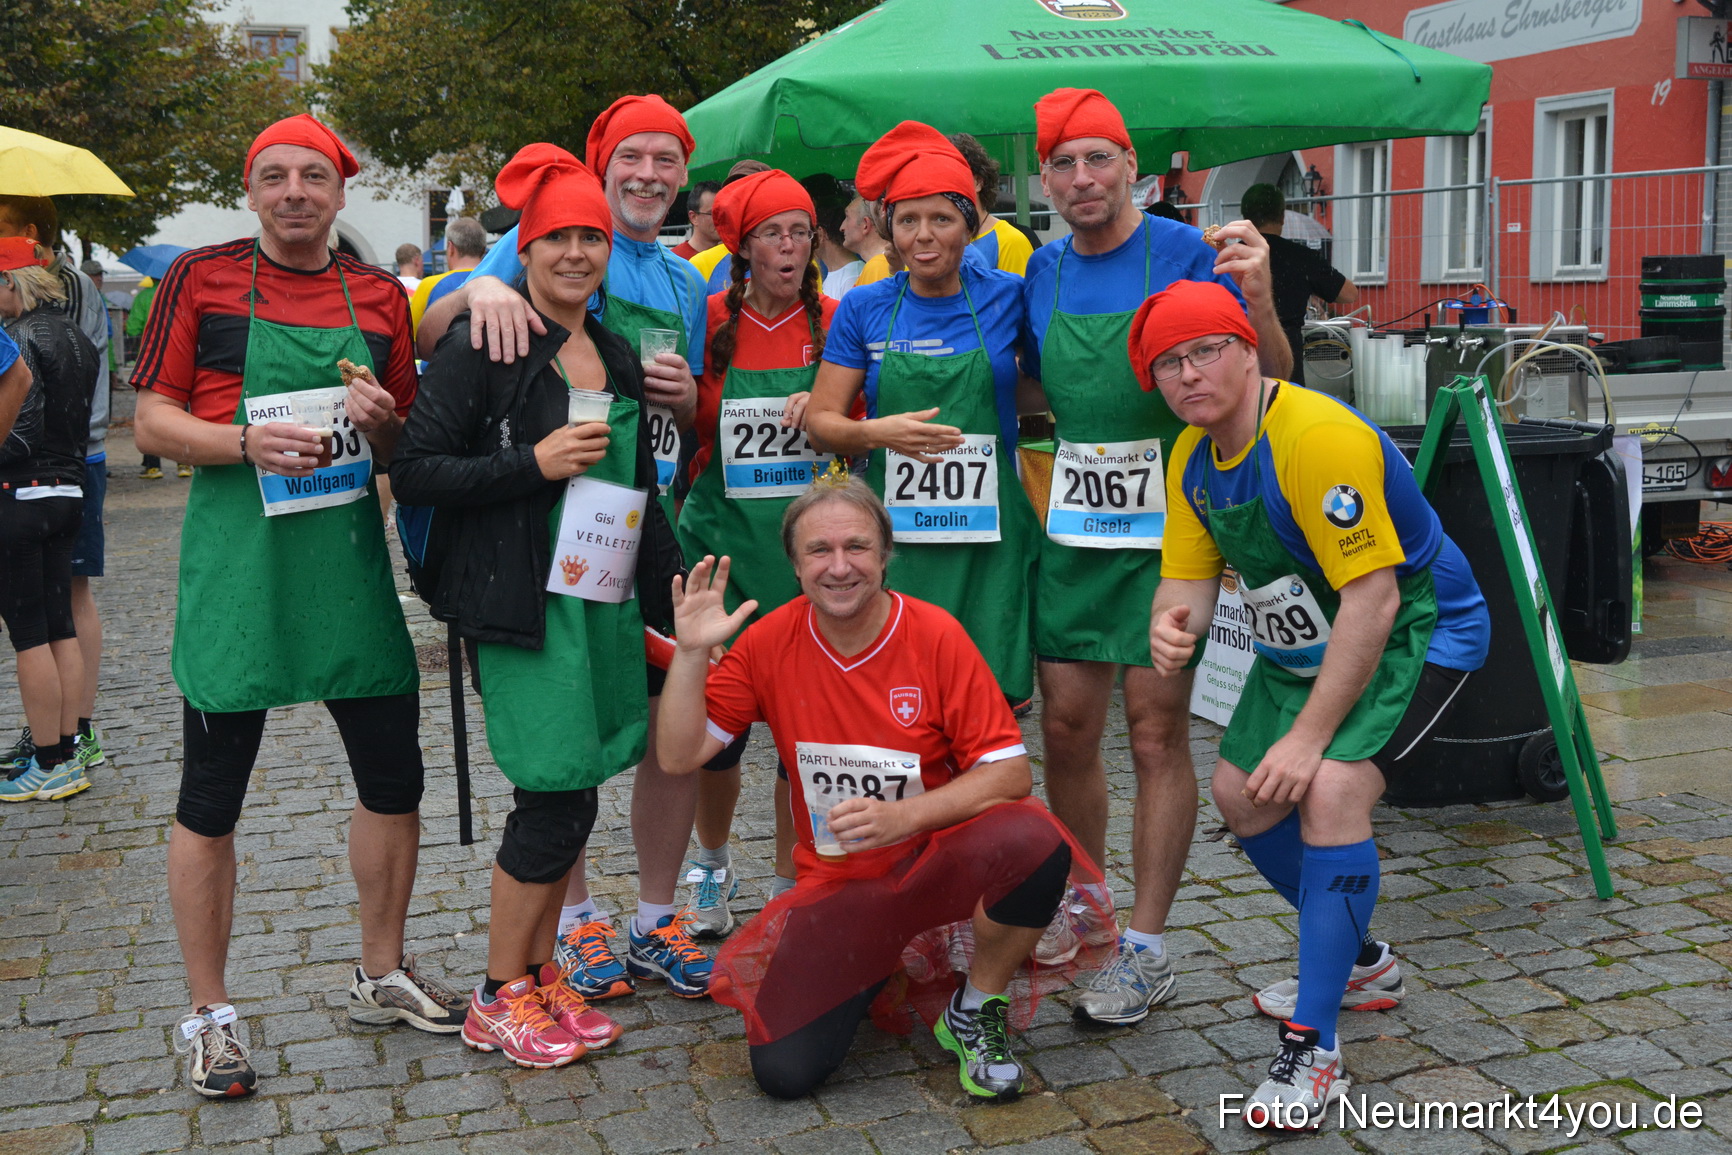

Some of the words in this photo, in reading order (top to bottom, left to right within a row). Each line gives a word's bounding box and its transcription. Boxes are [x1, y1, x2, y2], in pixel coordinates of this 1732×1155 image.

[1008, 27, 1215, 41] Neumarkter
[1413, 12, 1496, 50] Gasthaus
[980, 40, 1279, 61] Lammsbräu
[1689, 65, 1732, 76] ANGELG
[1651, 78, 1672, 106] 19
[1654, 299, 1697, 308] Lammsbräu
[250, 405, 293, 421] PARTL
[723, 408, 760, 418] PARTL
[762, 408, 784, 418] Neu
[650, 413, 676, 456] 96
[733, 422, 824, 460] 222
[1058, 449, 1083, 465] PARTL
[1084, 453, 1140, 465] Neumarkt
[285, 472, 355, 495] Wolfgang
[754, 468, 806, 485] Brigitte
[896, 461, 988, 501] 2407
[1063, 467, 1151, 509] 2067
[595, 512, 615, 526] Gisi
[914, 511, 968, 527] Carolin
[1083, 517, 1132, 534] Gisela
[576, 529, 637, 551] VERLETZT
[1338, 527, 1375, 551] PARTL
[1341, 538, 1377, 559] Neumarkt
[1207, 673, 1226, 689] Genuss
[893, 692, 918, 700] SUISSE
[799, 753, 837, 767] PARTL
[839, 756, 897, 769] Neumarkt
